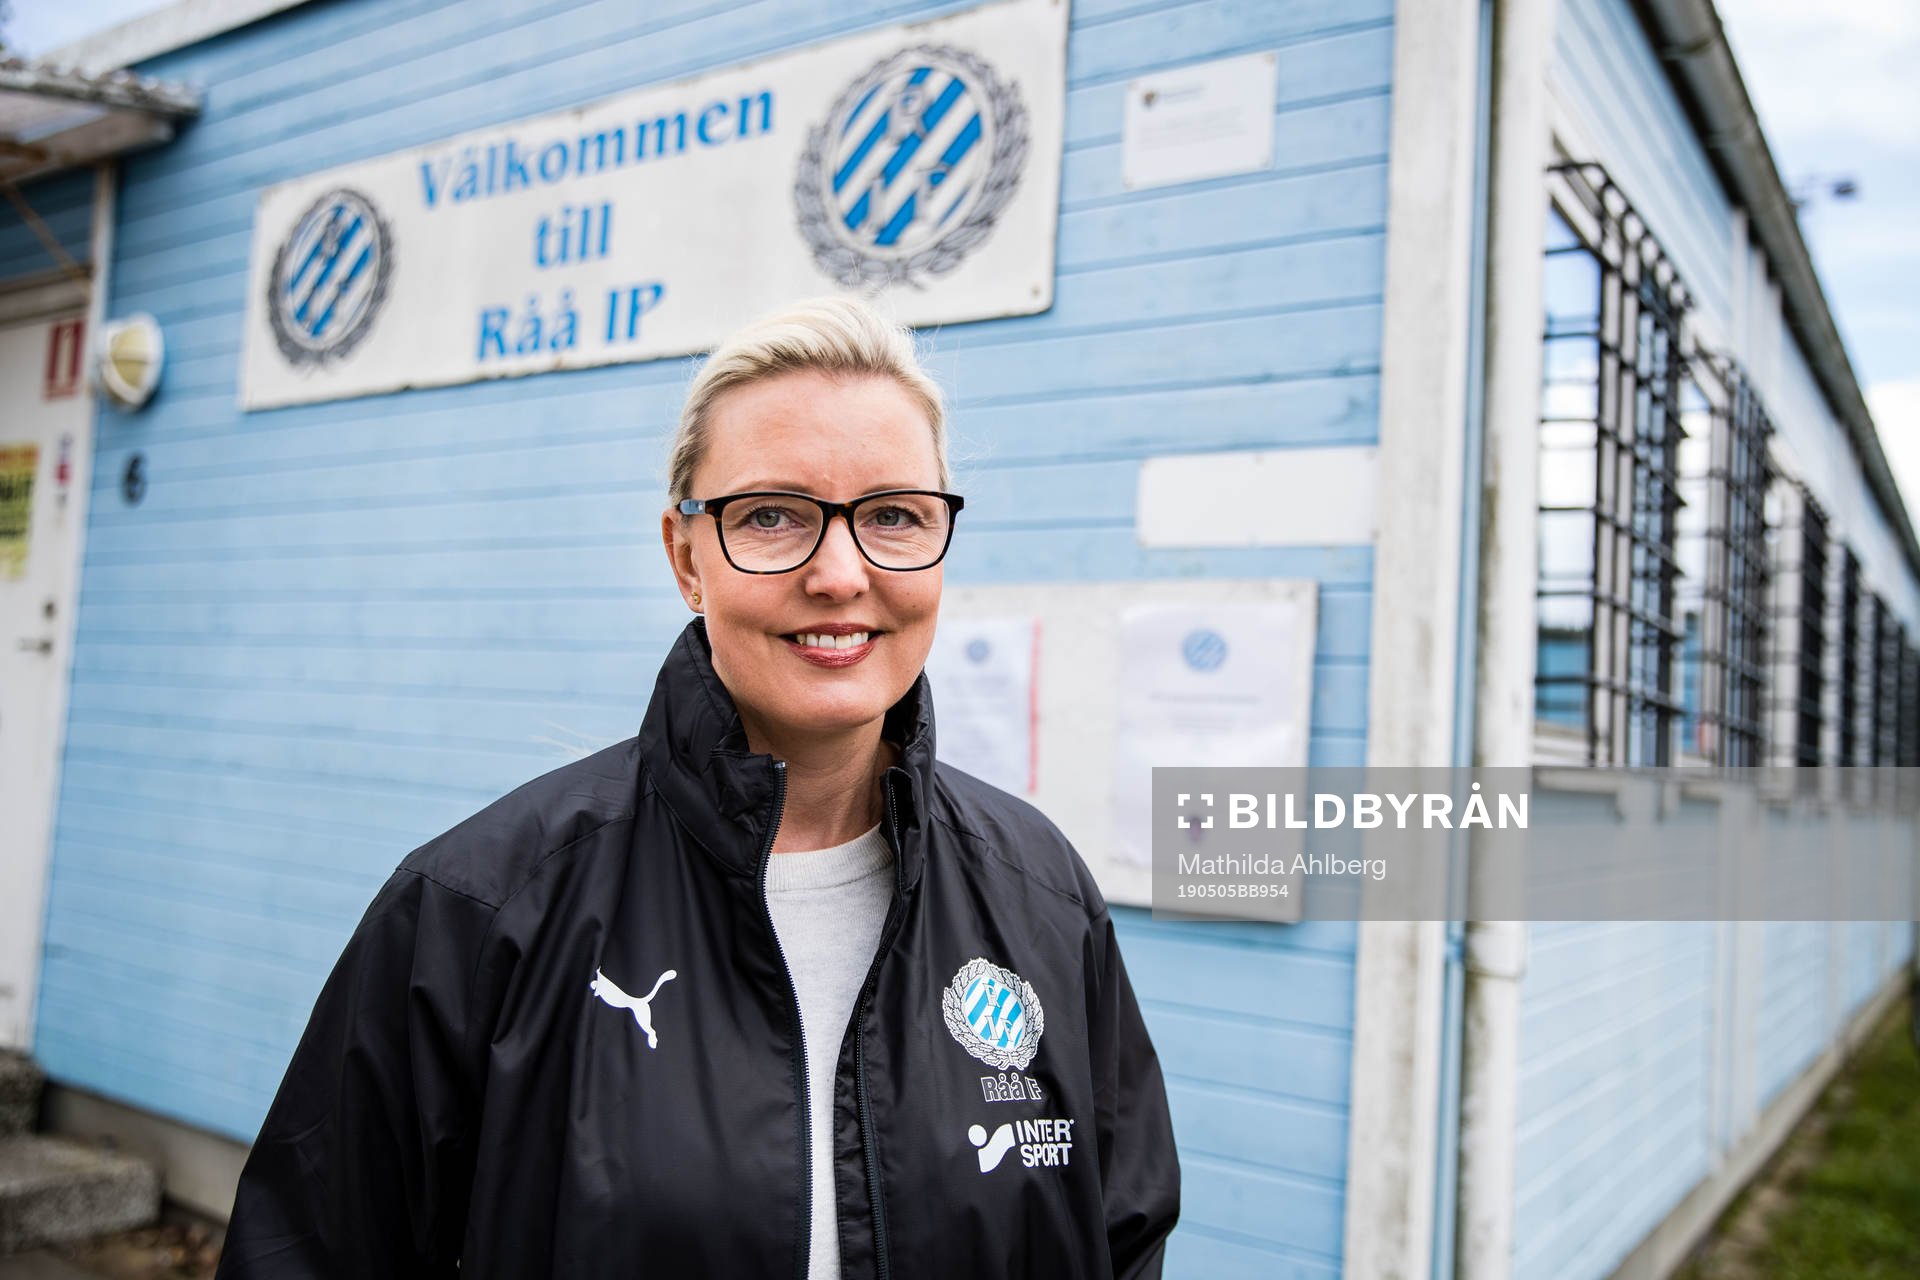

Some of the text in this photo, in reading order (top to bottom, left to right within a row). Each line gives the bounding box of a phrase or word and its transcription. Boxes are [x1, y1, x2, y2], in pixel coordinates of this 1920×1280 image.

[420, 88, 775, 206] Välkommen
[535, 201, 612, 268] till
[476, 282, 664, 361] Råå IP
[121, 453, 147, 506] 6
[980, 1072, 1026, 1102] Råå
[1016, 1119, 1072, 1143] INTER
[1020, 1143, 1072, 1168] SPORT
